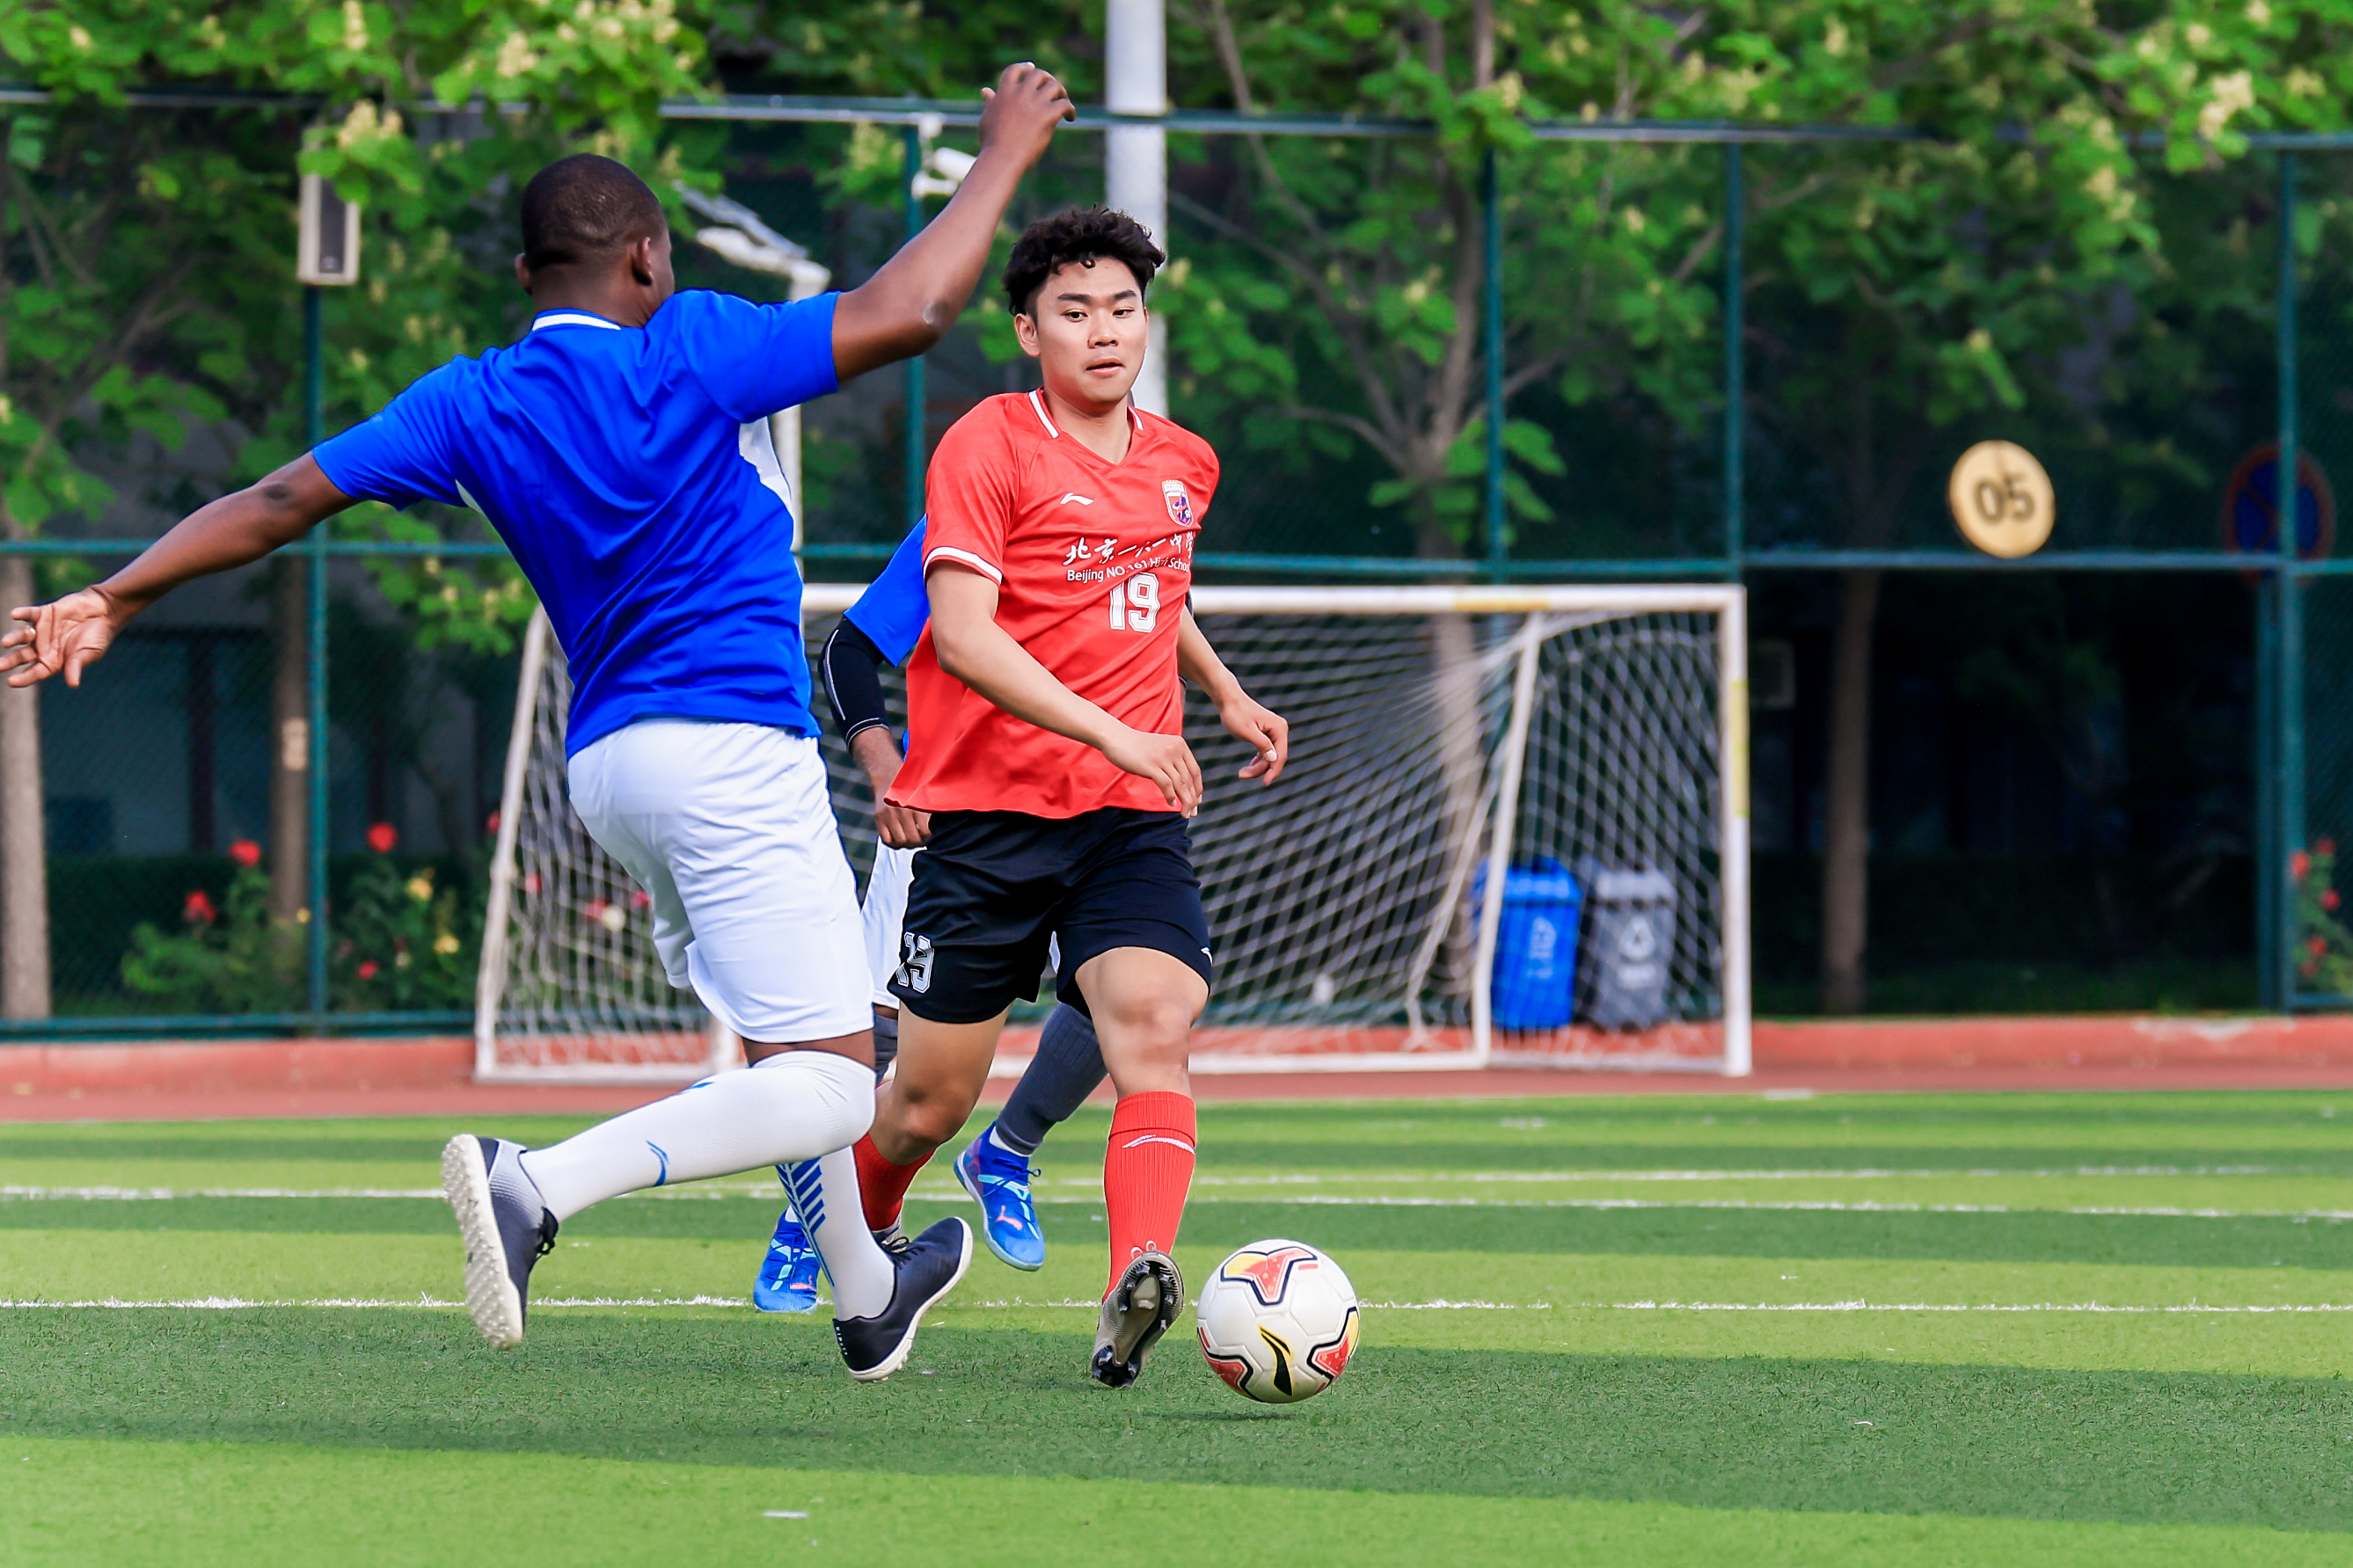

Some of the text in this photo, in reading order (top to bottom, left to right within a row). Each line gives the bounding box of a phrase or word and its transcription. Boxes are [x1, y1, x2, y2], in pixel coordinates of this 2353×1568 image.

[1973, 472, 2035, 525] 05
[1067, 569, 1104, 583] Beijing
[1109, 572, 1161, 633] 19
